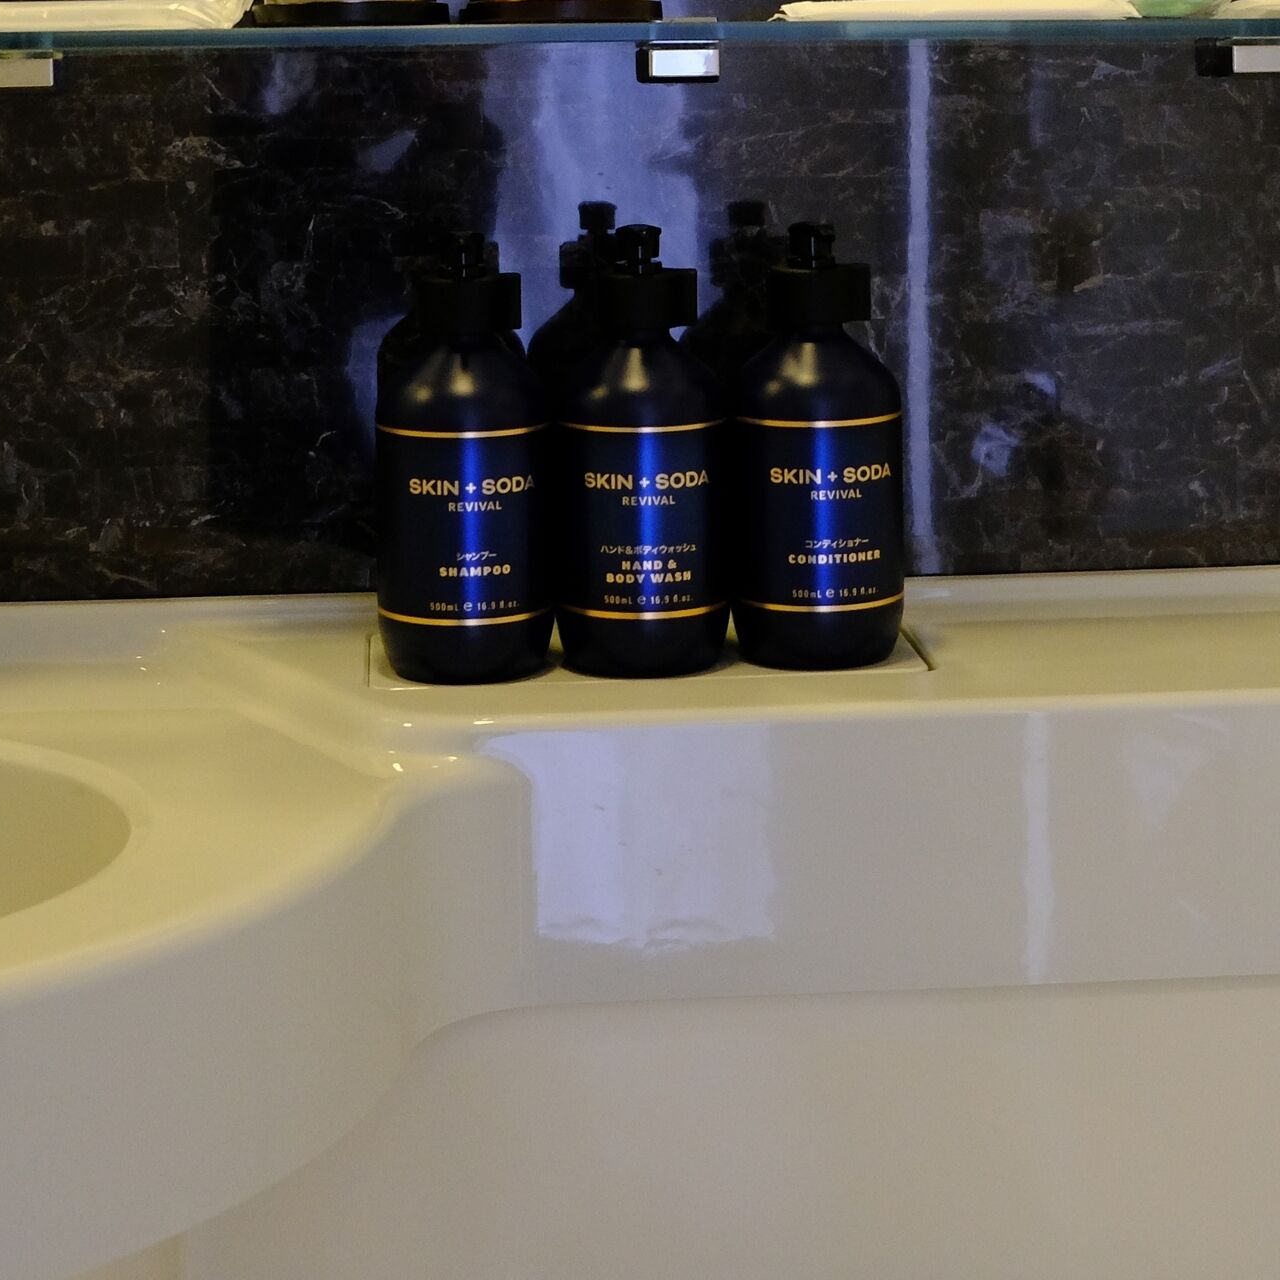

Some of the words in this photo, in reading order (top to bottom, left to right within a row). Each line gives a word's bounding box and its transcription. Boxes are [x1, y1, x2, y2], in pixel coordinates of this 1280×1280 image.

[584, 472, 633, 490] SKIN
[639, 476, 650, 489] +
[655, 470, 710, 490] SODA
[770, 467, 822, 484] SKIN
[827, 471, 838, 483] +
[842, 463, 891, 484] SODA
[408, 478, 460, 496] SKIN
[465, 482, 477, 494] +
[482, 474, 535, 495] SODA
[622, 495, 676, 506] REVIVAL
[810, 488, 862, 500] REVIVAL
[448, 500, 502, 512] REVIVAL
[805, 537, 869, 549] コンディショナー
[788, 549, 880, 565] CONDITIONER
[439, 564, 511, 577] SHAMPOO
[622, 560, 662, 570] HAND
[667, 559, 677, 570] &
[606, 572, 645, 584] BODY
[650, 570, 691, 584] WASH
